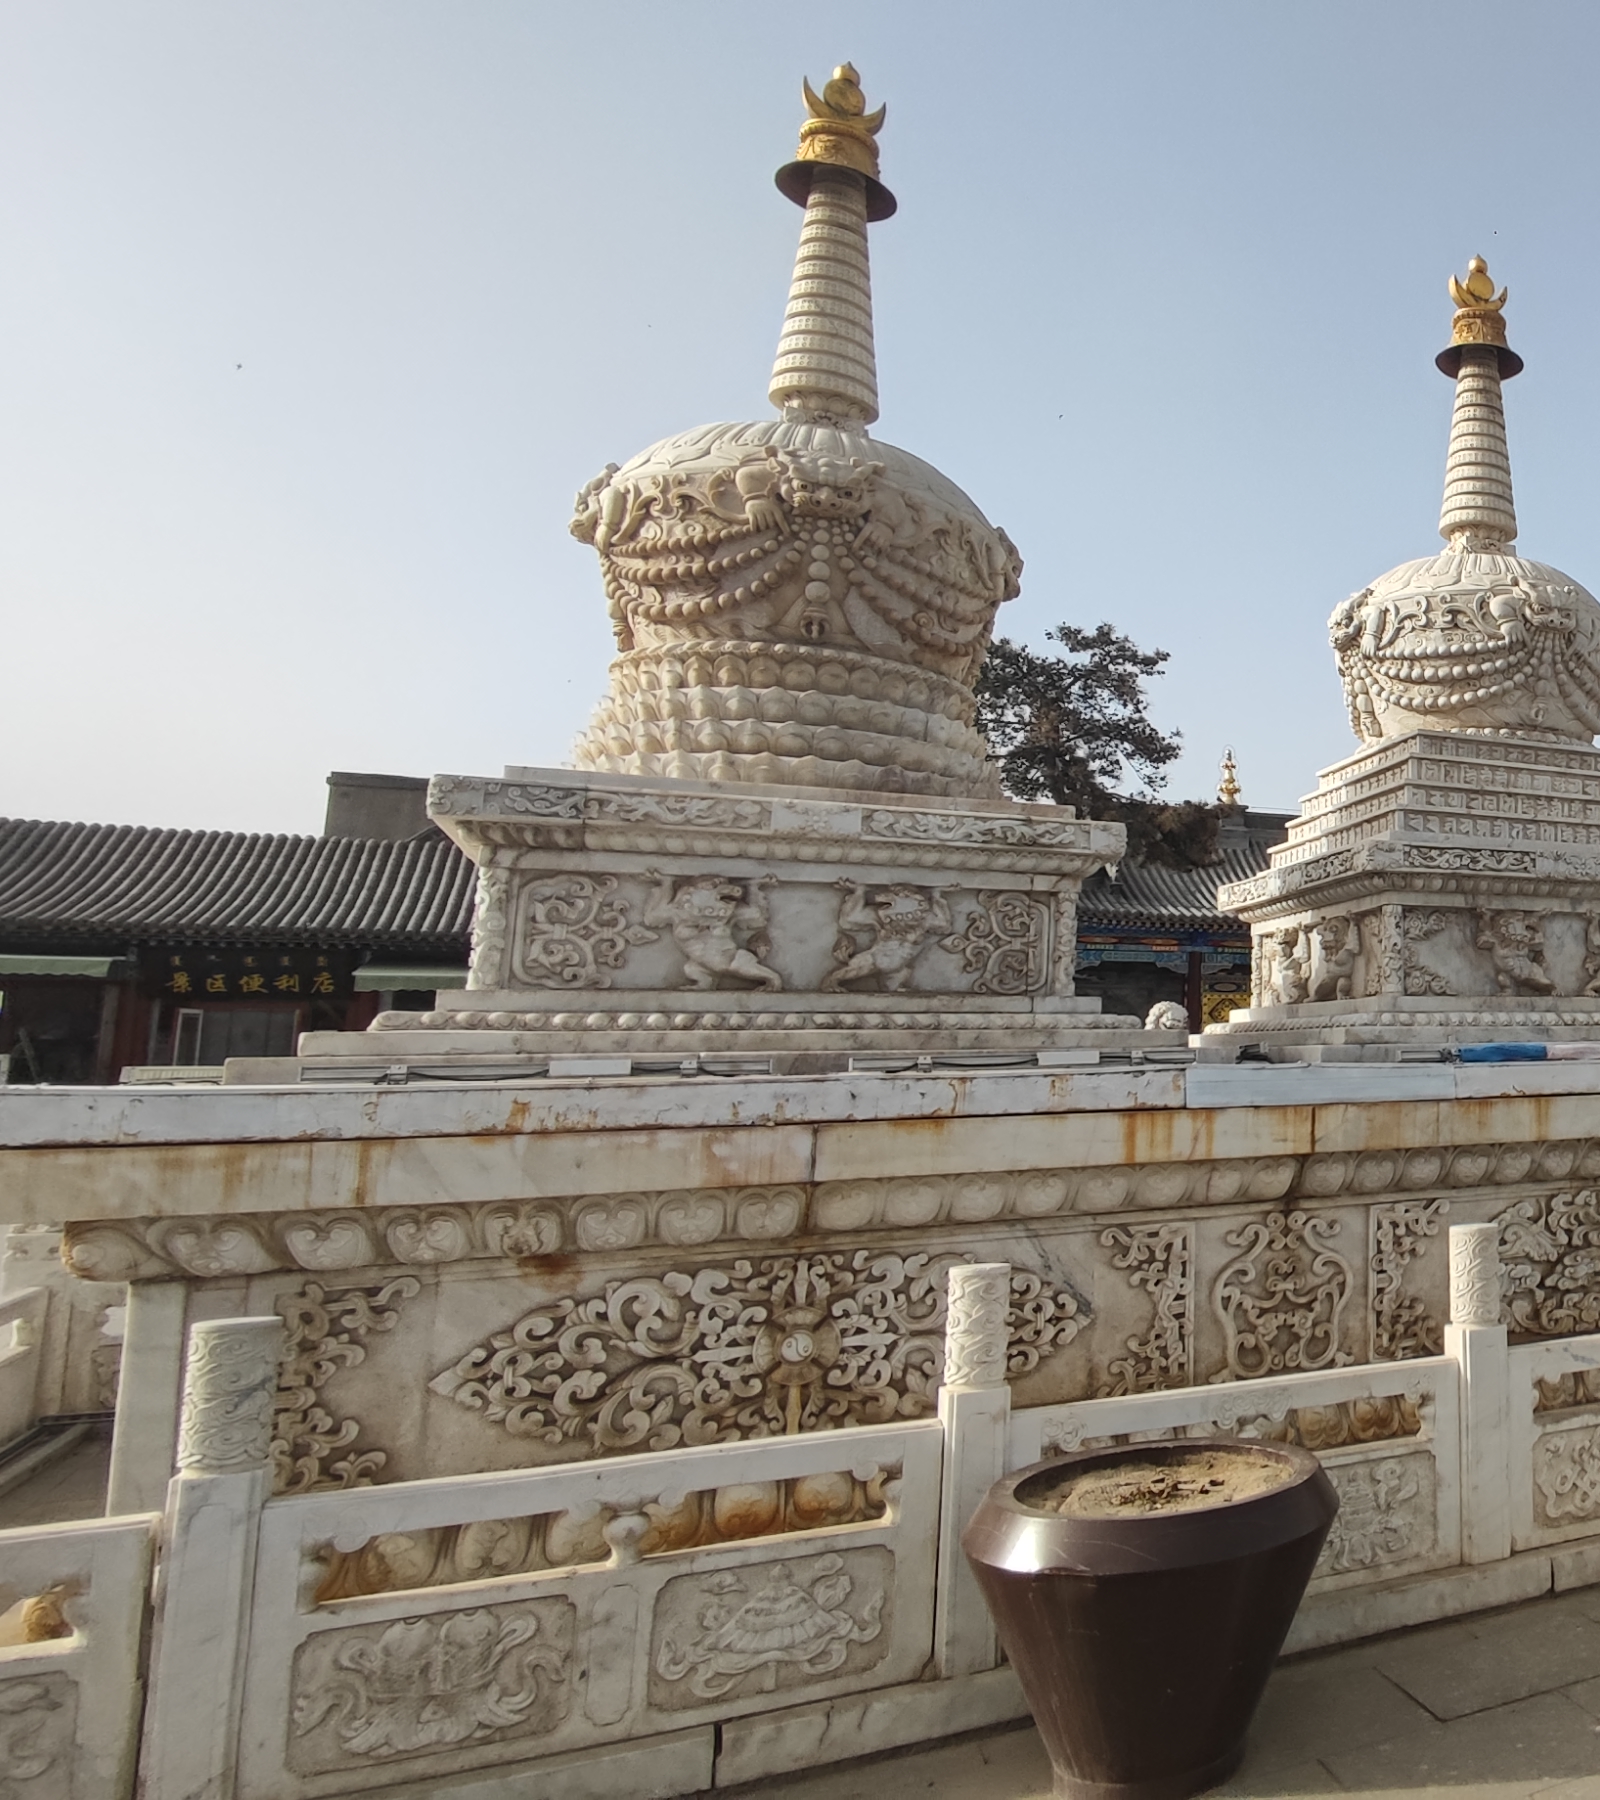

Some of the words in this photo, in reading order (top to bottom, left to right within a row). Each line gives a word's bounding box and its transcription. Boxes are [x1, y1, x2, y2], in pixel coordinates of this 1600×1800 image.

[165, 972, 335, 994] 景区便利店
